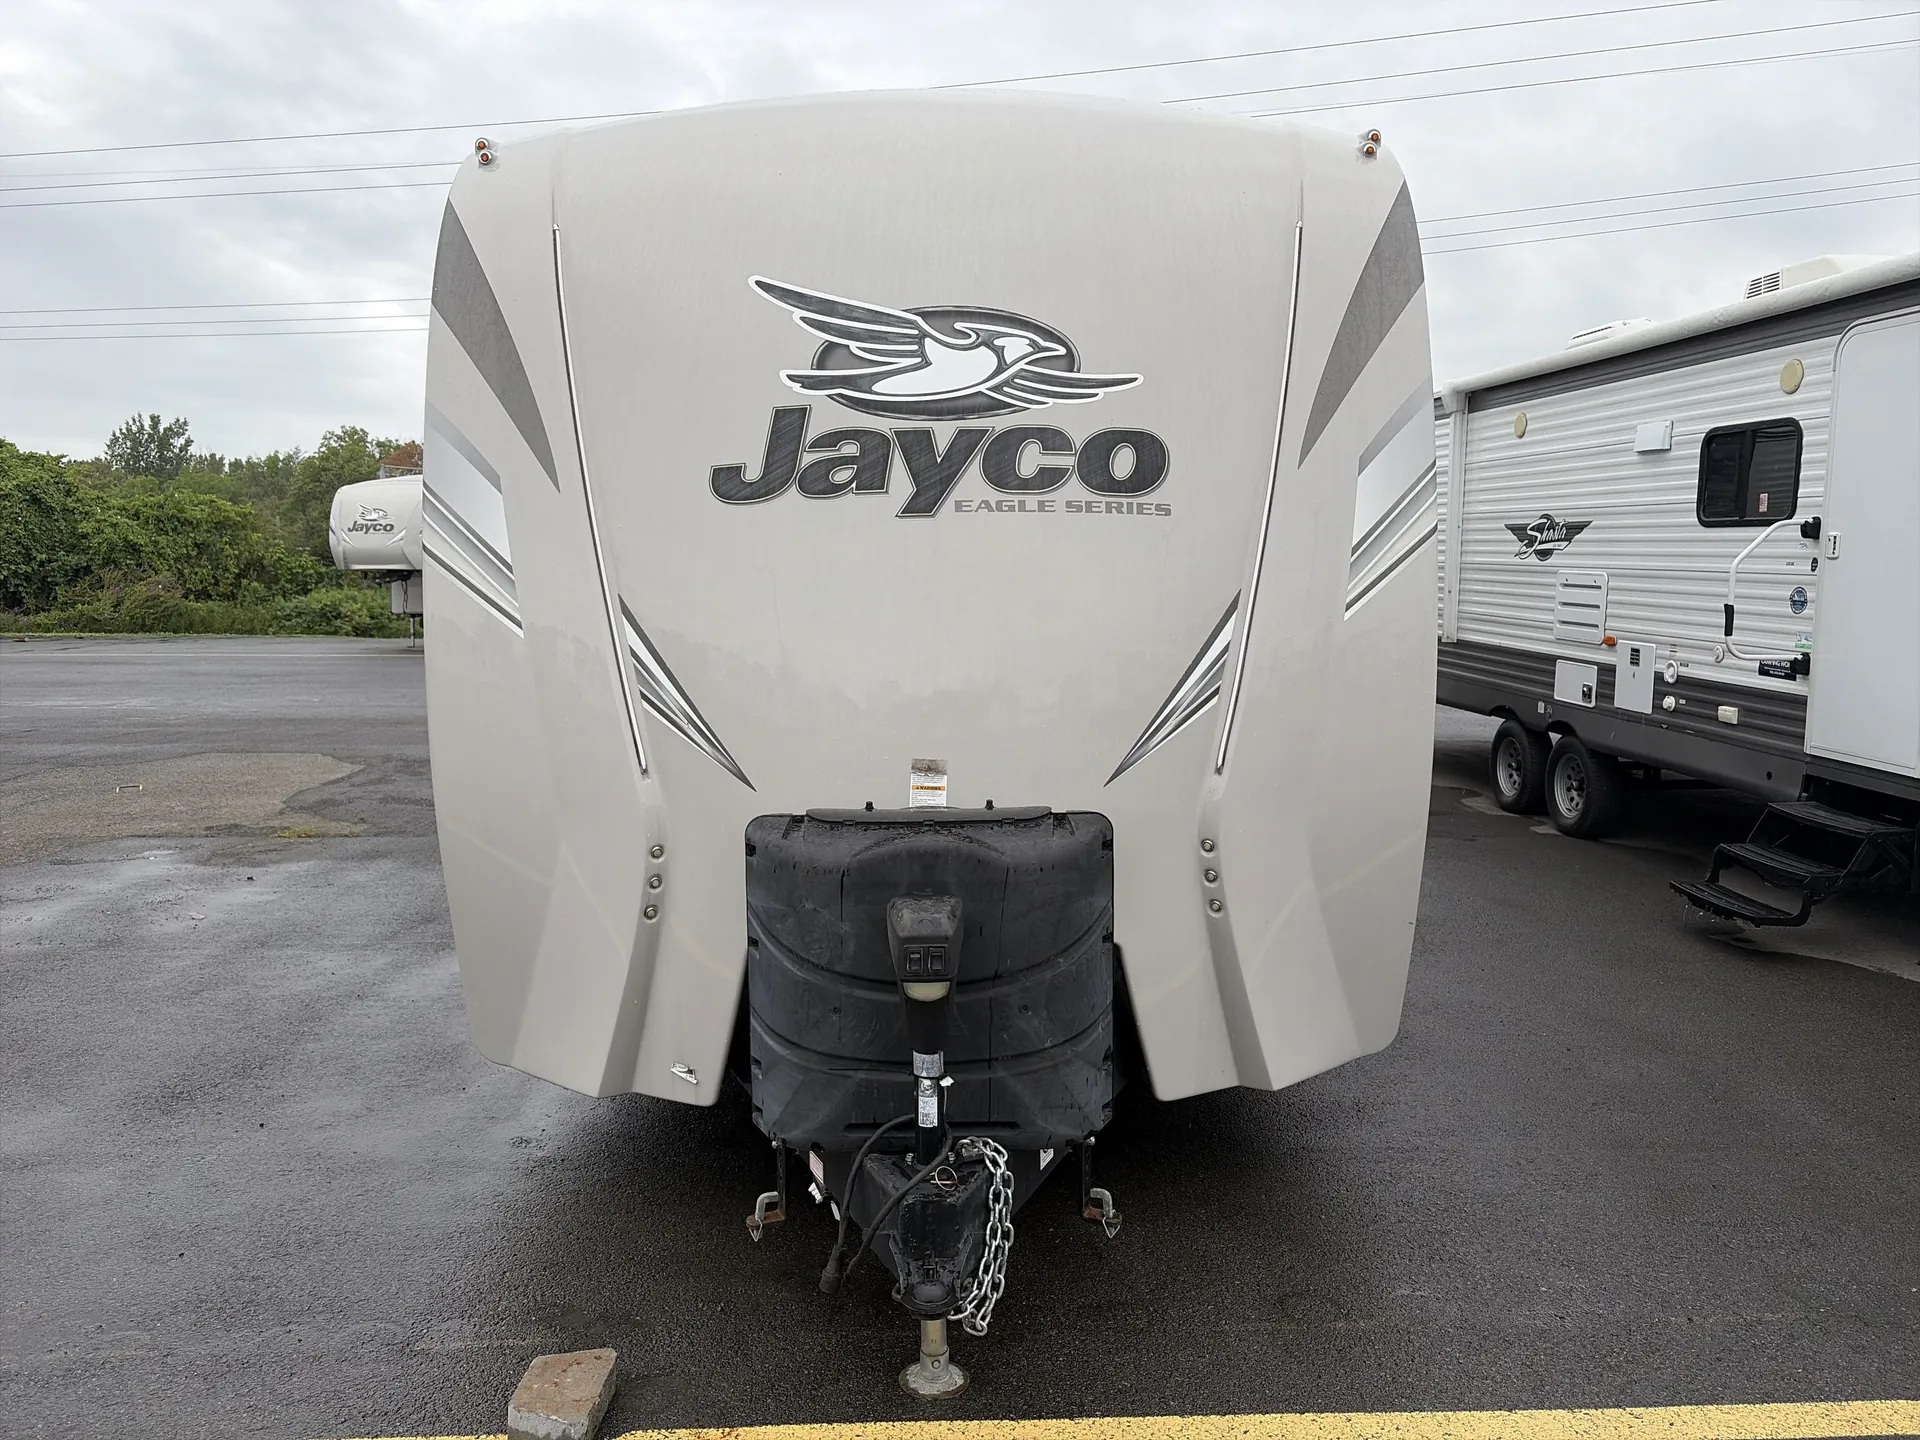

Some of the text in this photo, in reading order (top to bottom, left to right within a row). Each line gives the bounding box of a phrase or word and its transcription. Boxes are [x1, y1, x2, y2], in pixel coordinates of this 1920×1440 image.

[709, 404, 1170, 519] Jayco
[954, 499, 1172, 517] EAGLE SERIES
[347, 520, 395, 534] Jayco
[1515, 518, 1567, 560] Shasta
